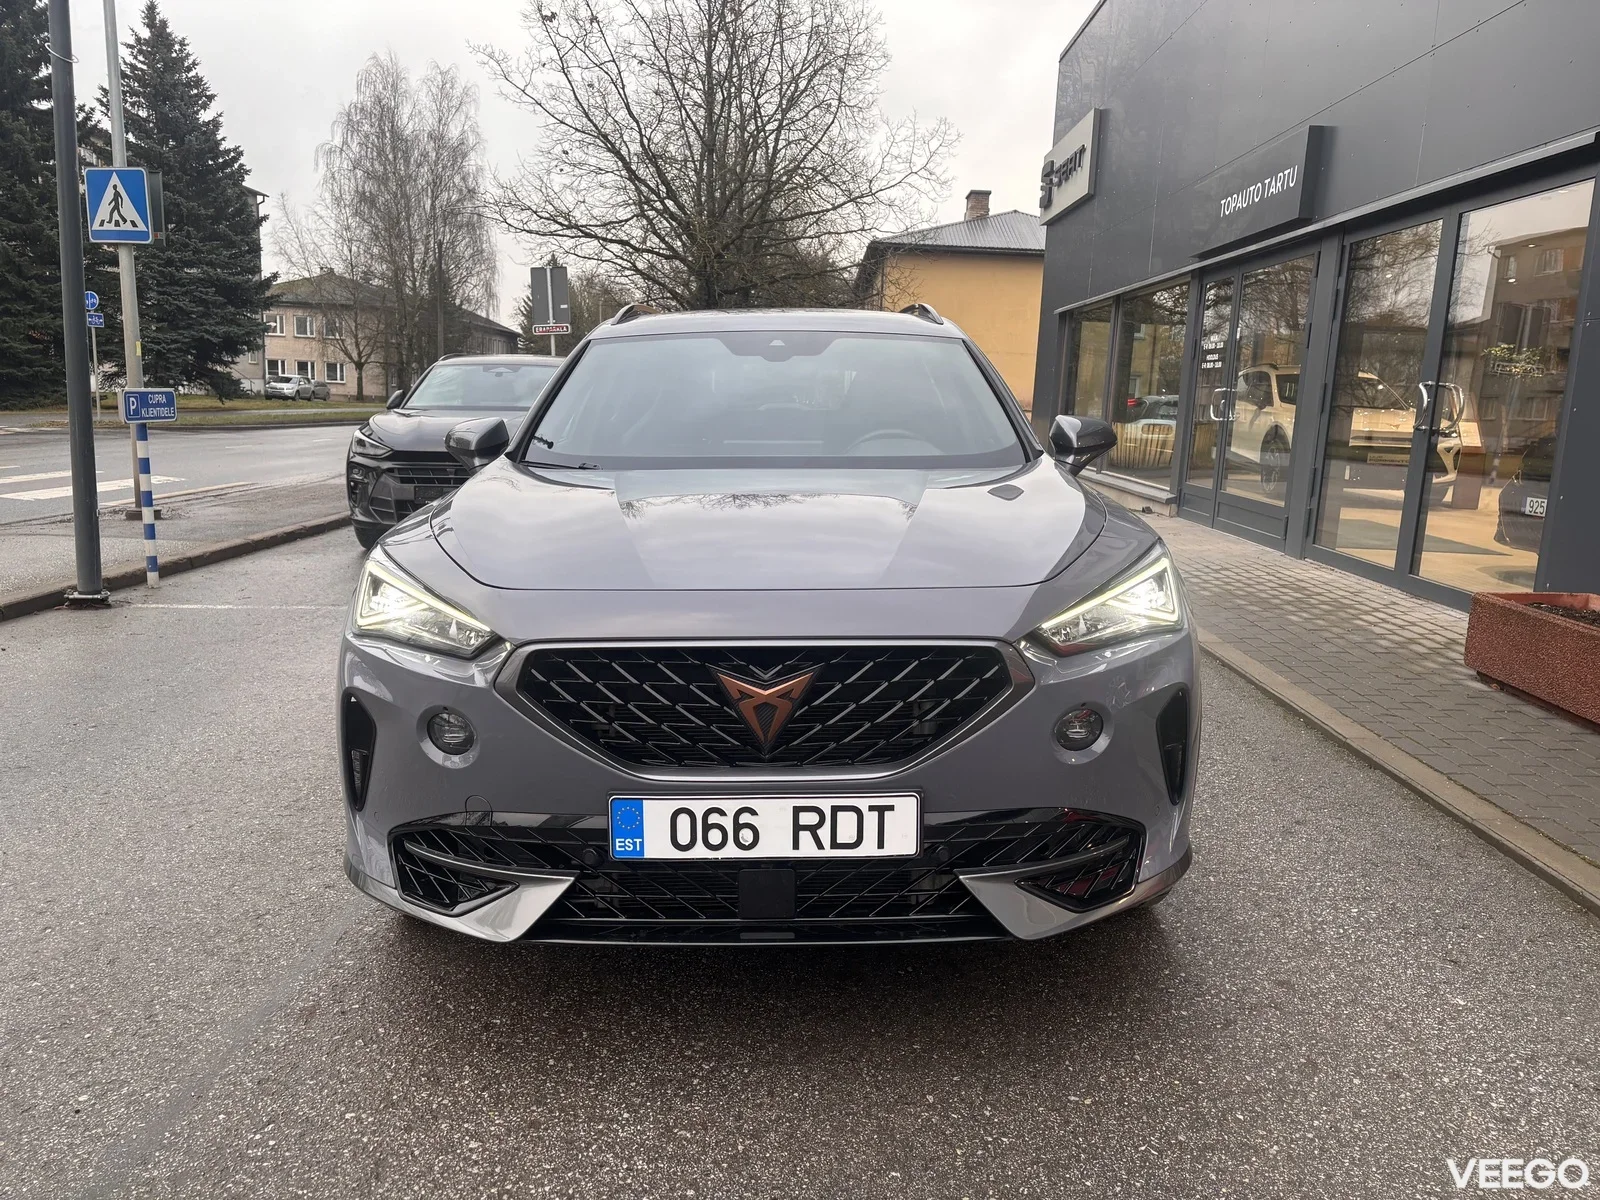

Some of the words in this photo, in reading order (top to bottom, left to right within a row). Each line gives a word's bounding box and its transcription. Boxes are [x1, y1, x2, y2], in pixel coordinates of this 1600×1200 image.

[1054, 144, 1086, 187] SEAT
[1220, 186, 1262, 218] TOPAUTO
[1264, 165, 1298, 200] TARTU
[130, 397, 137, 414] P
[148, 394, 166, 404] CUPRA
[142, 407, 174, 418] KLIENTIDELE
[1528, 499, 1546, 515] 925
[669, 806, 760, 852] 066
[792, 804, 895, 851] RDT
[615, 838, 643, 852] EST
